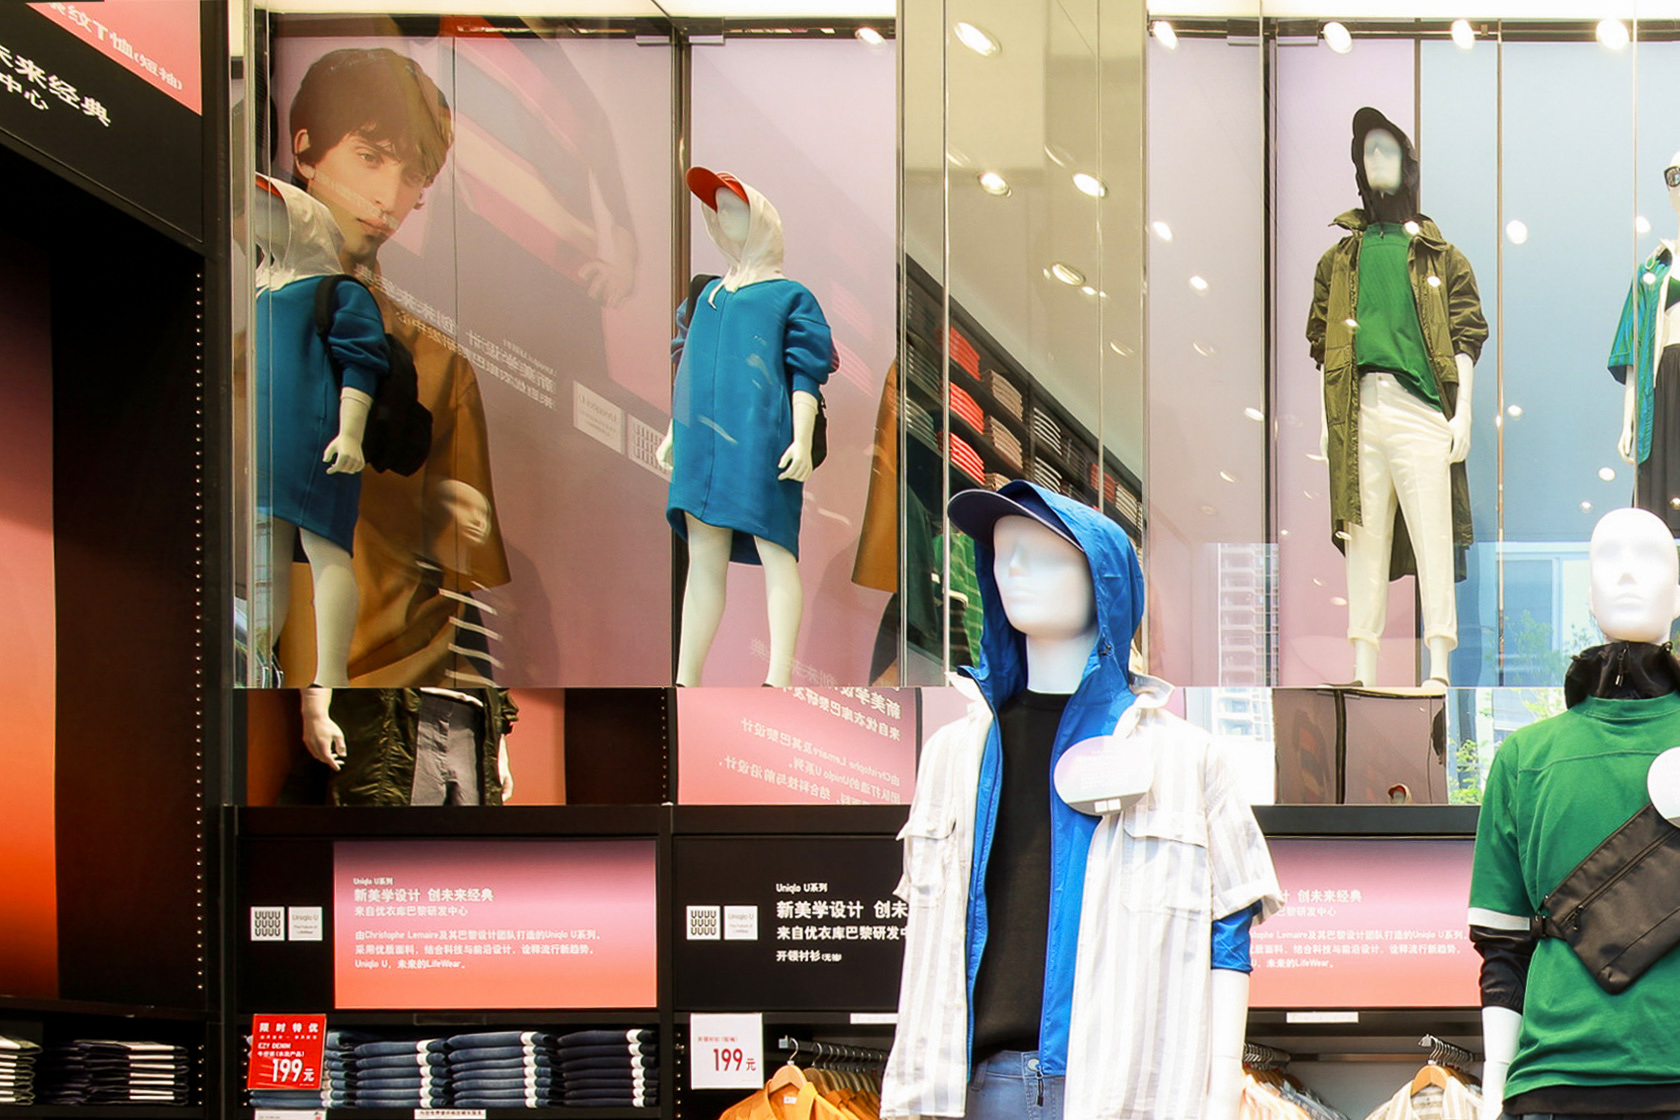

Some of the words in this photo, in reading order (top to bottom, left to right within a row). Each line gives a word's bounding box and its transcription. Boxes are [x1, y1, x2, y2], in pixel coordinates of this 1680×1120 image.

[354, 888, 420, 902] 新美学设计
[428, 888, 494, 902] 创未来经典
[1298, 889, 1363, 903] 创未来经典
[354, 905, 468, 917] 来自优衣库巴黎研发中心
[776, 901, 864, 919] 新美学设计
